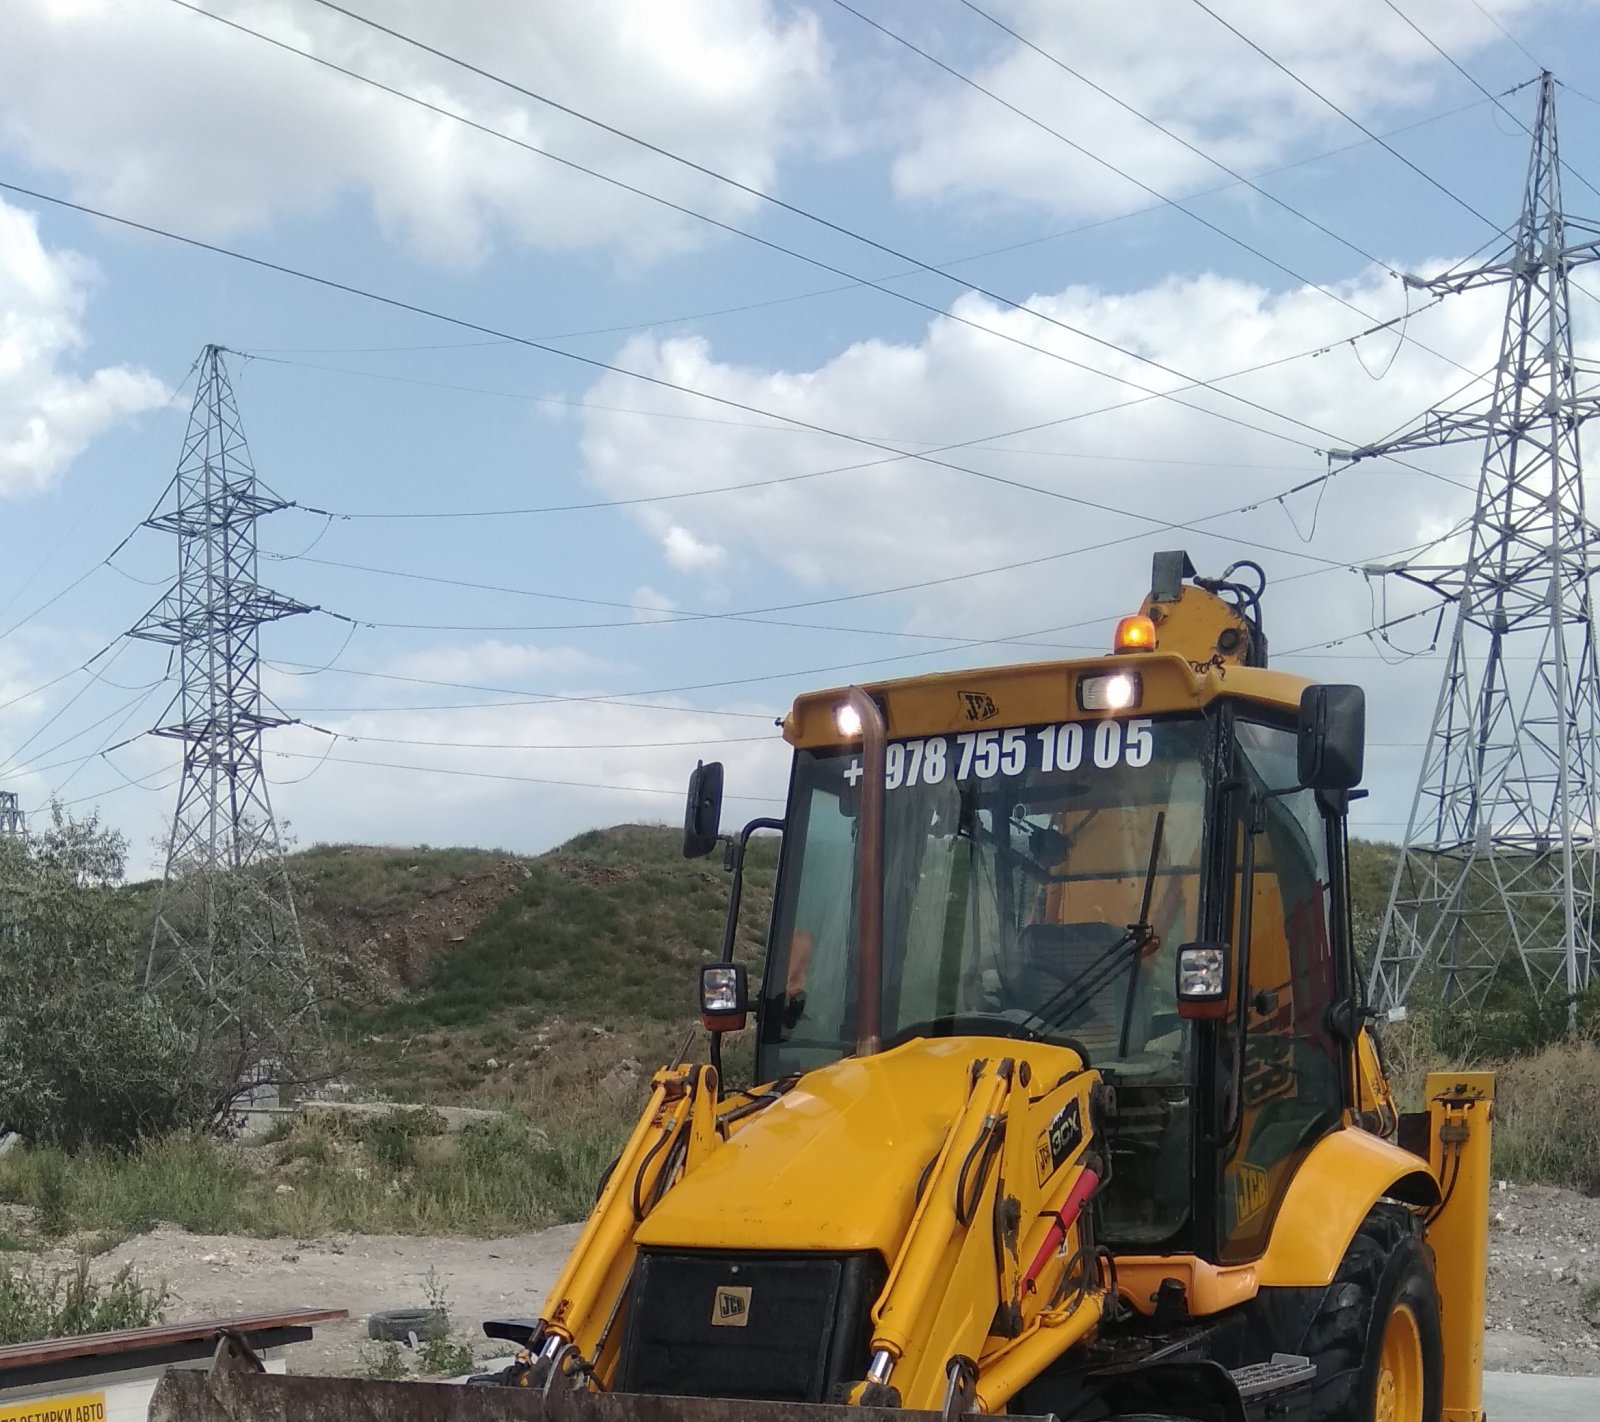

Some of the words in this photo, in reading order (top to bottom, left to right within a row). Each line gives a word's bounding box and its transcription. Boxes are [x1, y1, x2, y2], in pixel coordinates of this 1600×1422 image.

[886, 737, 947, 790] 978
[956, 728, 1026, 781] 755
[1037, 722, 1083, 772] 10
[1093, 719, 1153, 769] 05
[1051, 1110, 1080, 1156] 3CX
[1238, 1166, 1266, 1219] JCB
[721, 1295, 744, 1316] JCB
